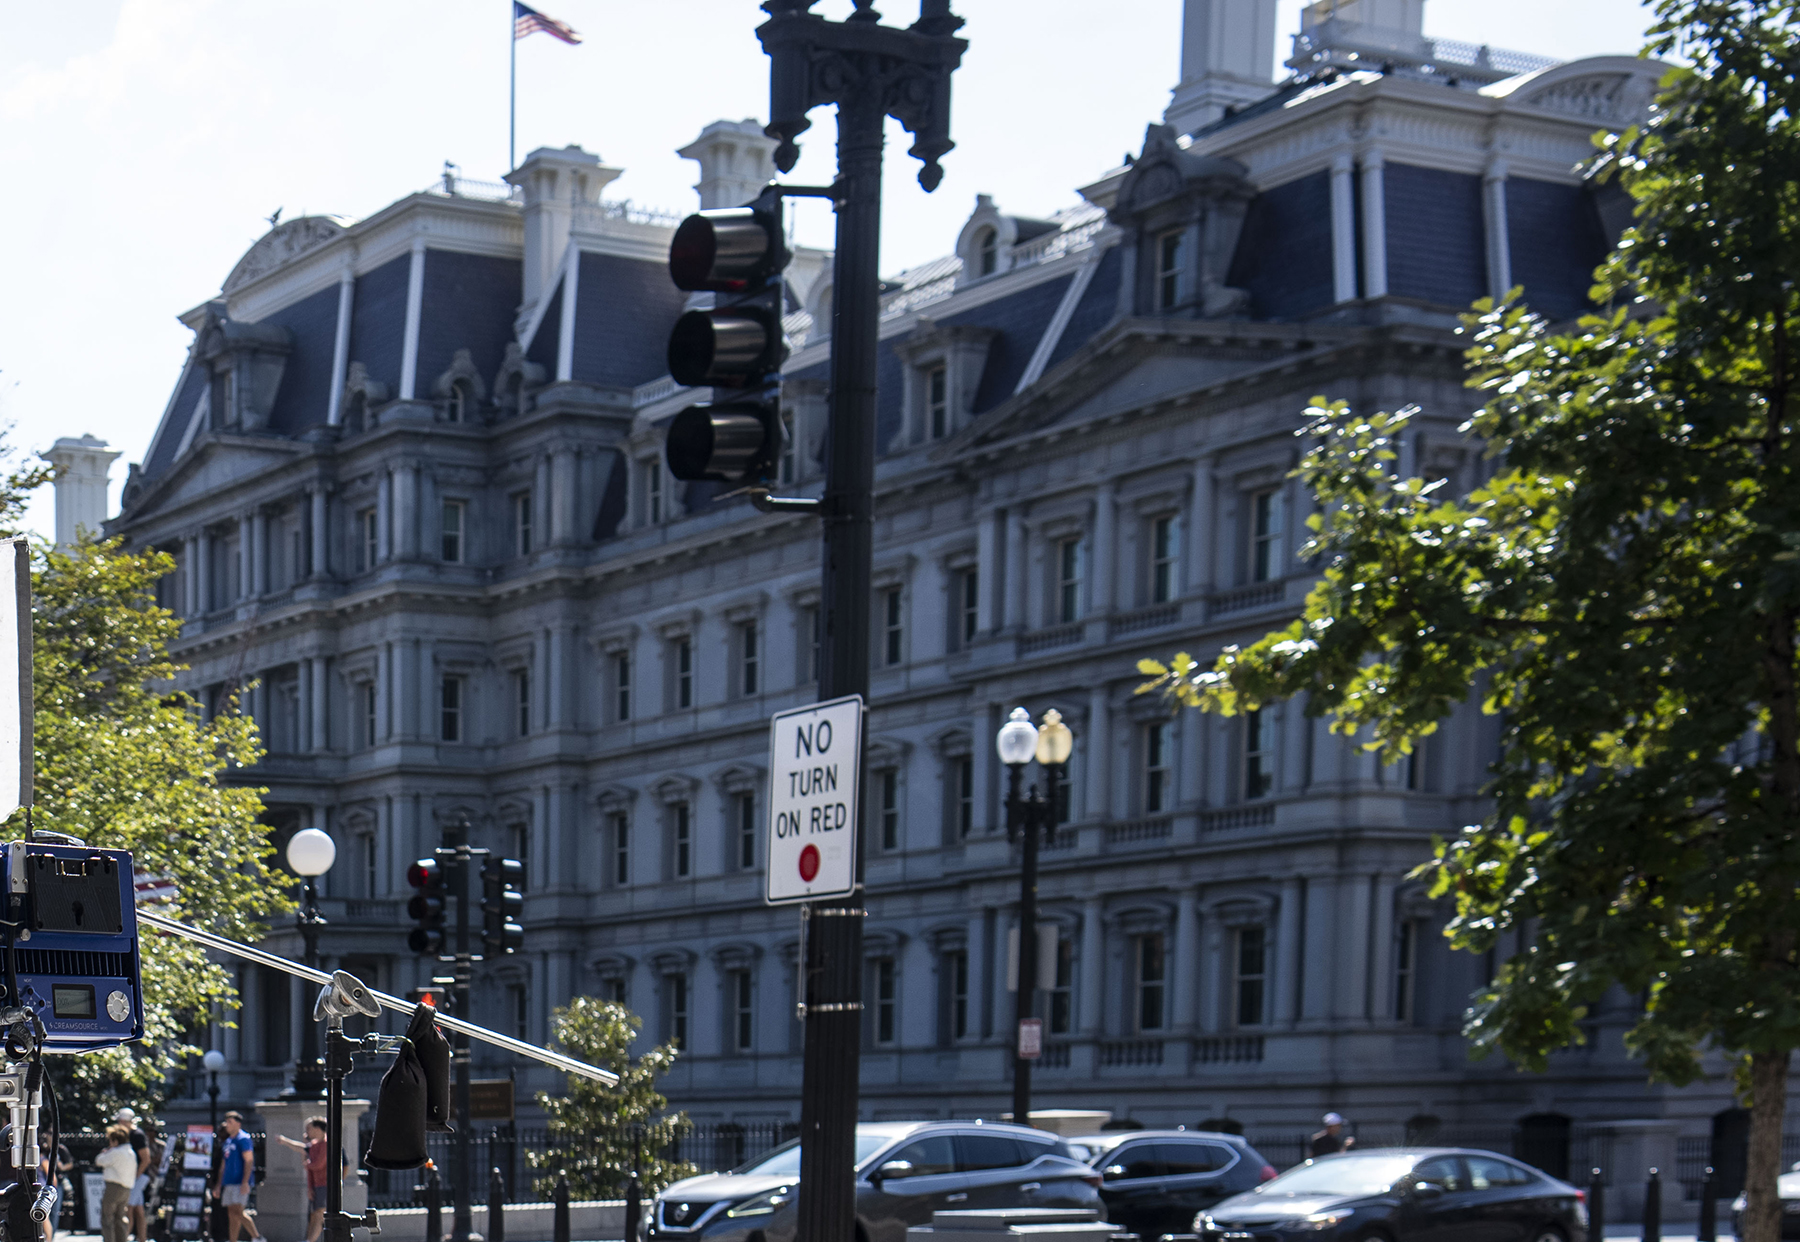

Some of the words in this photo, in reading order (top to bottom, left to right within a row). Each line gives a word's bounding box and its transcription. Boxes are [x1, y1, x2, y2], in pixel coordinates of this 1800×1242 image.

[796, 719, 833, 759] NO
[789, 764, 838, 799] TURN
[777, 810, 801, 839] ON
[810, 802, 847, 835] RED
[53, 1022, 98, 1031] CREAMSOURCE
